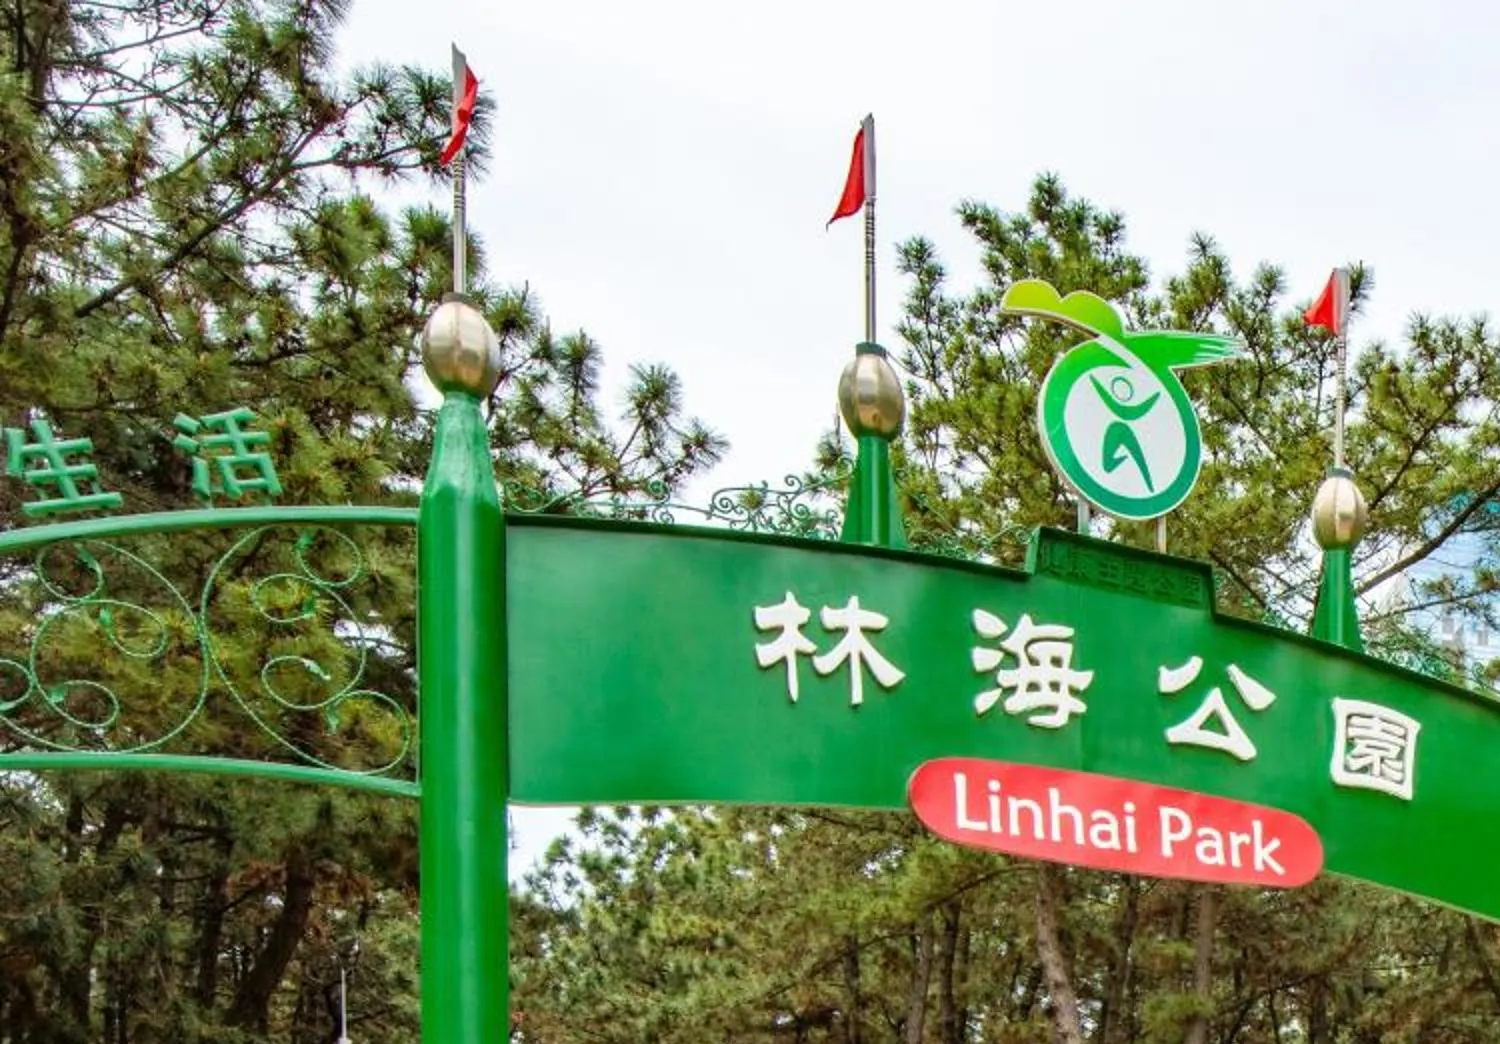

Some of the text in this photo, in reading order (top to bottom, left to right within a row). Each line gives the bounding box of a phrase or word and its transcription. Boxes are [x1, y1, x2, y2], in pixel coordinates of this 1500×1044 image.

[1, 407, 283, 516] 生活
[953, 771, 1287, 876] Linhai Park
